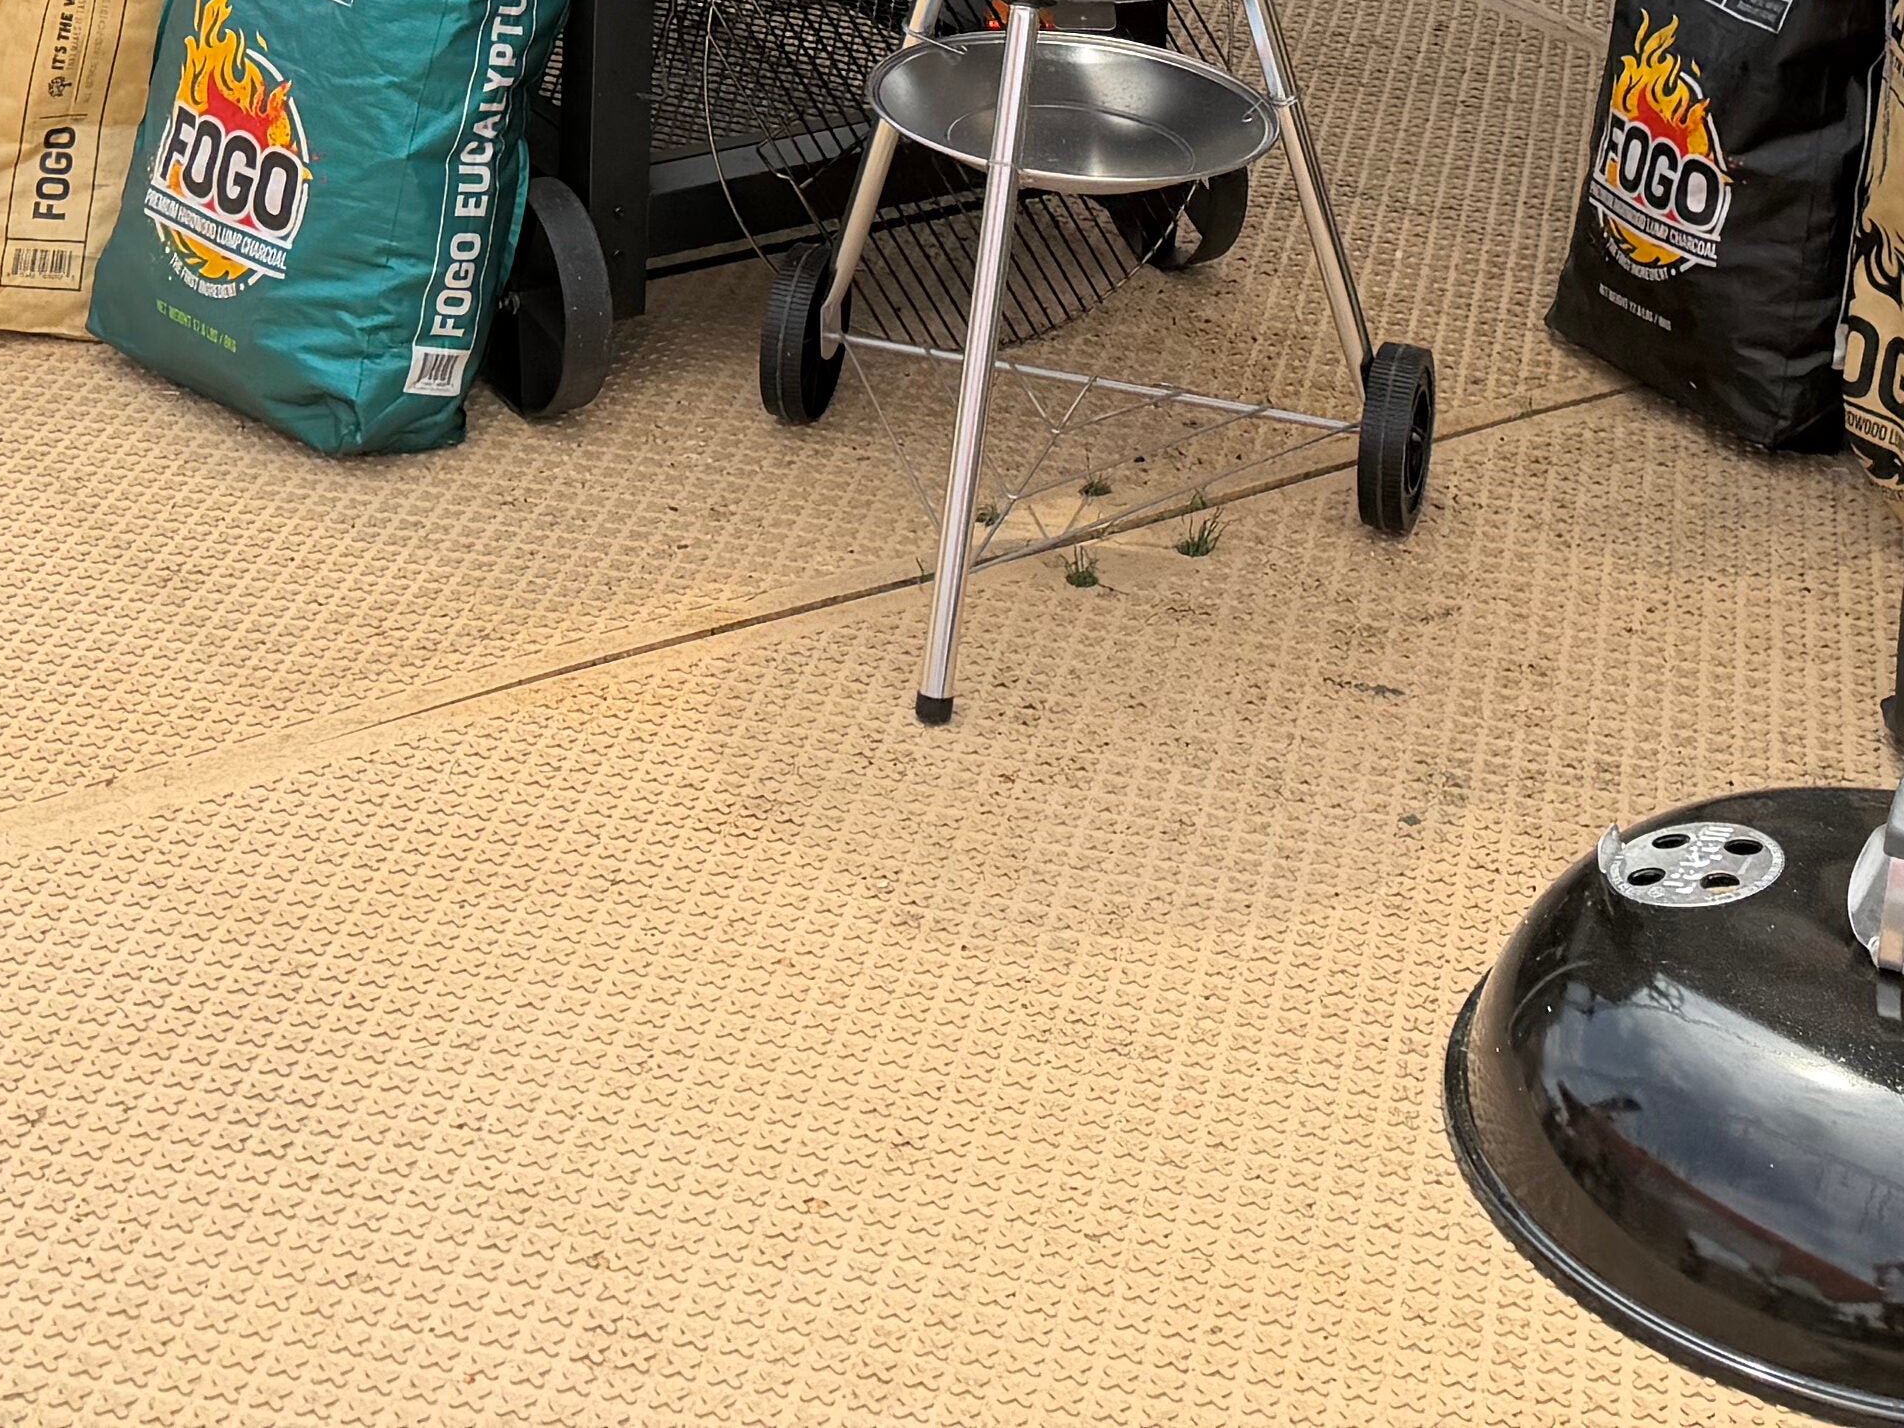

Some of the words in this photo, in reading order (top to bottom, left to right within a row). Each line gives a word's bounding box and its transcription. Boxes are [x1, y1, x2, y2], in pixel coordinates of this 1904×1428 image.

[51, 42, 68, 72] IT'S
[58, 12, 75, 41] THE
[32, 125, 77, 221] FOGO
[159, 103, 302, 234] FOGO
[1600, 116, 1722, 233] FOGO
[144, 187, 179, 213] PREMIUM
[216, 224, 242, 250] LUMP
[241, 236, 287, 271] CHARCOAL
[1669, 227, 1717, 259] CHARCOAL
[431, 233, 481, 339] FOGO
